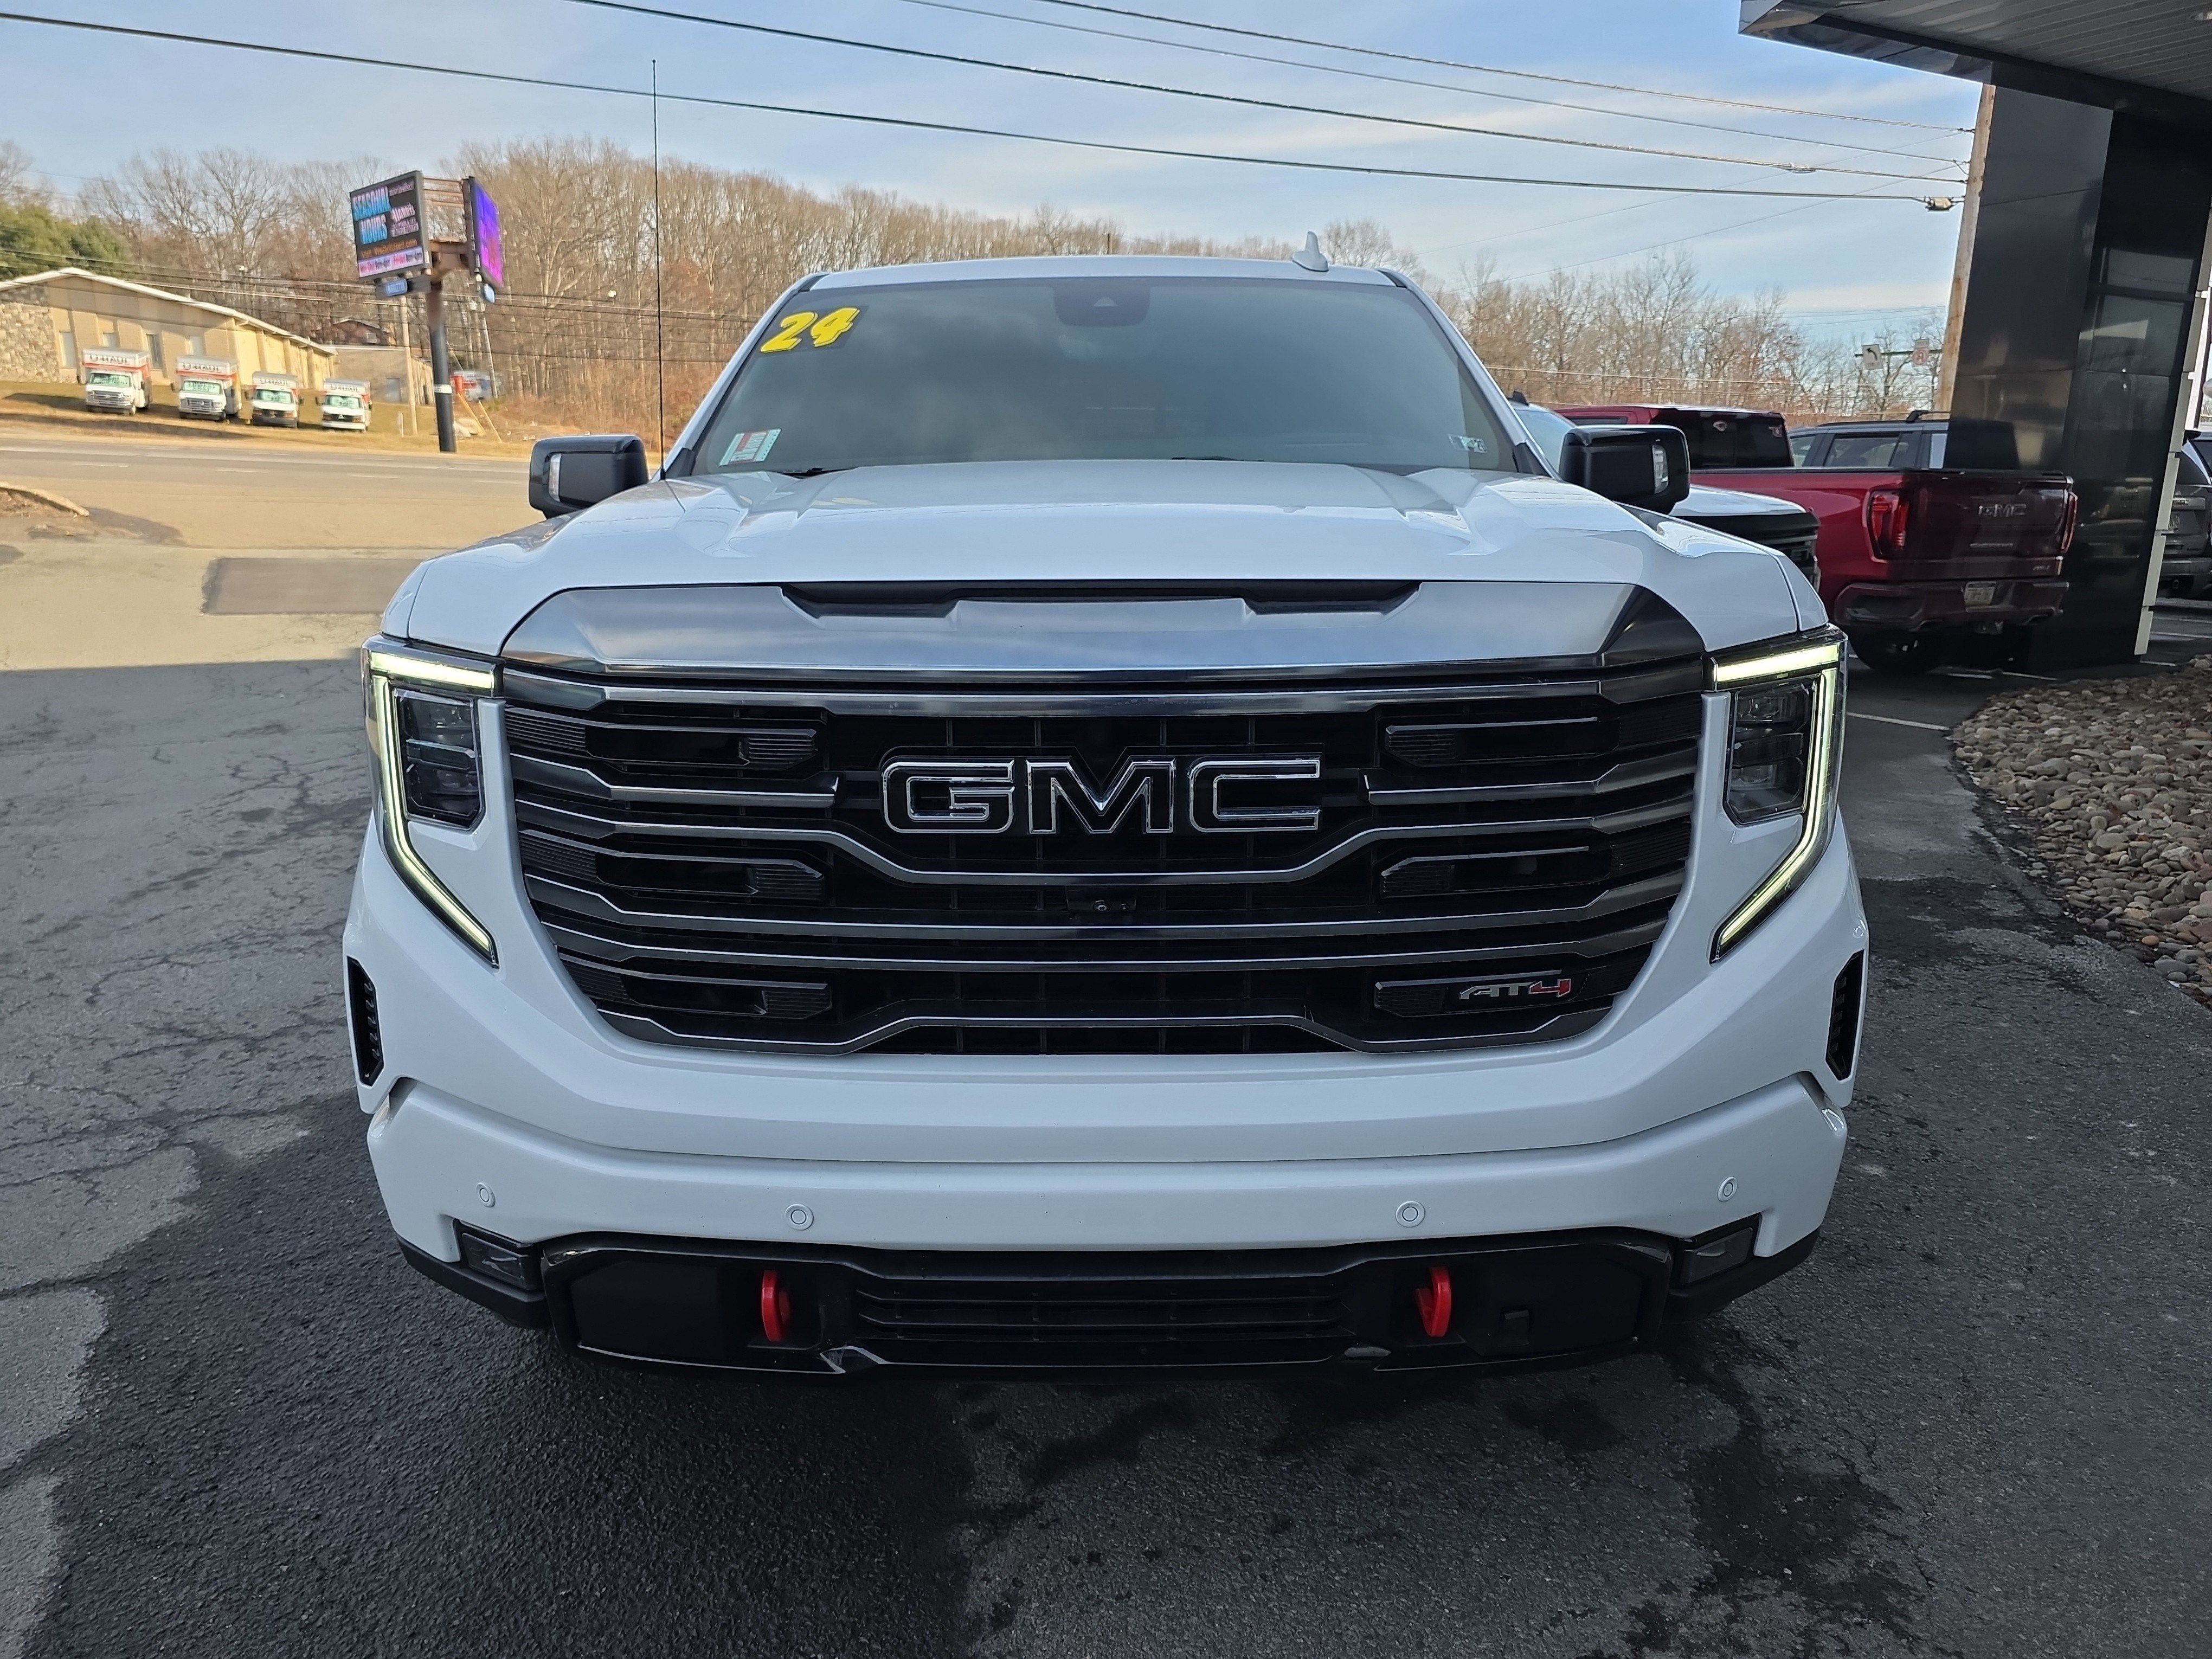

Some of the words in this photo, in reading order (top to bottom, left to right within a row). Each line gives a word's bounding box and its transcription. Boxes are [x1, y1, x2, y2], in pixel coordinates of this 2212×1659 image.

[353, 186, 390, 221] SEASONAL
[359, 214, 388, 244] HOURS
[760, 306, 860, 353] 24
[1978, 503, 2027, 518] GMC
[881, 758, 1321, 834] GMC
[1460, 979, 1571, 1000] AT4
